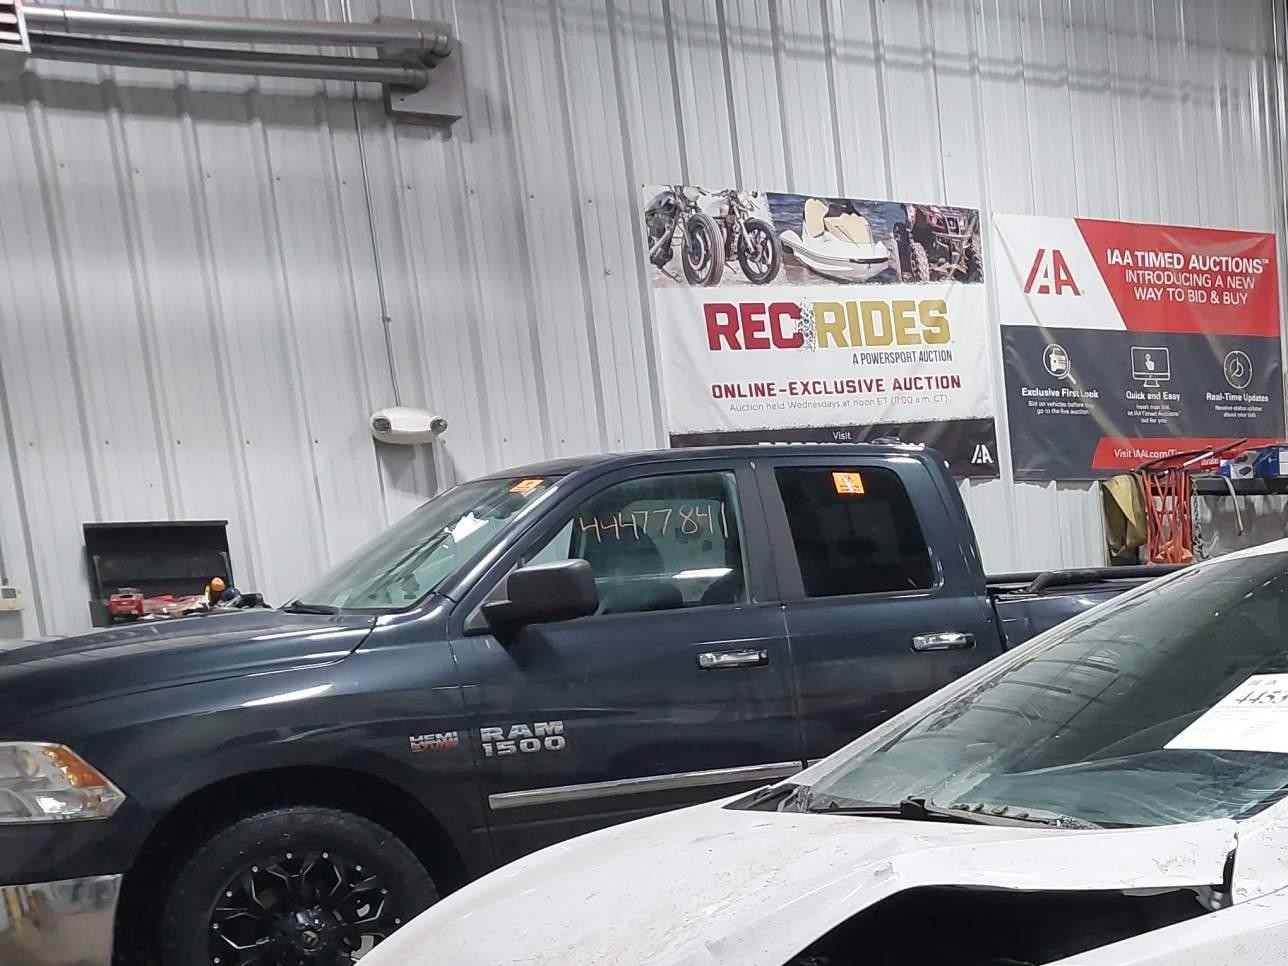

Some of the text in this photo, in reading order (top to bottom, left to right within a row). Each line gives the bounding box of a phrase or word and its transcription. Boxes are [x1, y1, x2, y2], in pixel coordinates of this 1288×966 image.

[1106, 248, 1133, 267] IAA
[1134, 251, 1185, 269] TIMED
[1125, 269, 1255, 289] INTRODUCING A NEW
[1133, 287, 1248, 305] WAY TO BID & BUY
[703, 299, 951, 350] REC RIDES
[852, 349, 953, 365] A POWERSPORT AUCTION
[711, 375, 962, 399] ONLINE-EXCLUSIVE AUCTION
[1021, 387, 1060, 397] Exclusive
[1061, 388, 1079, 398] First
[1125, 390, 1181, 402] Quick and Easy
[729, 402, 764, 412] Auction
[766, 401, 785, 411] held
[788, 399, 841, 410] Wednesdays
[842, 399, 851, 407] at
[853, 399, 875, 407] noon
[877, 396, 889, 406] ET
[1206, 392, 1269, 403] Real-Time Updates
[832, 431, 852, 440] Visit
[1114, 448, 1132, 459] Visit
[579, 501, 728, 543] 44477841
[480, 720, 564, 742] RAM
[482, 735, 566, 758] 1500
